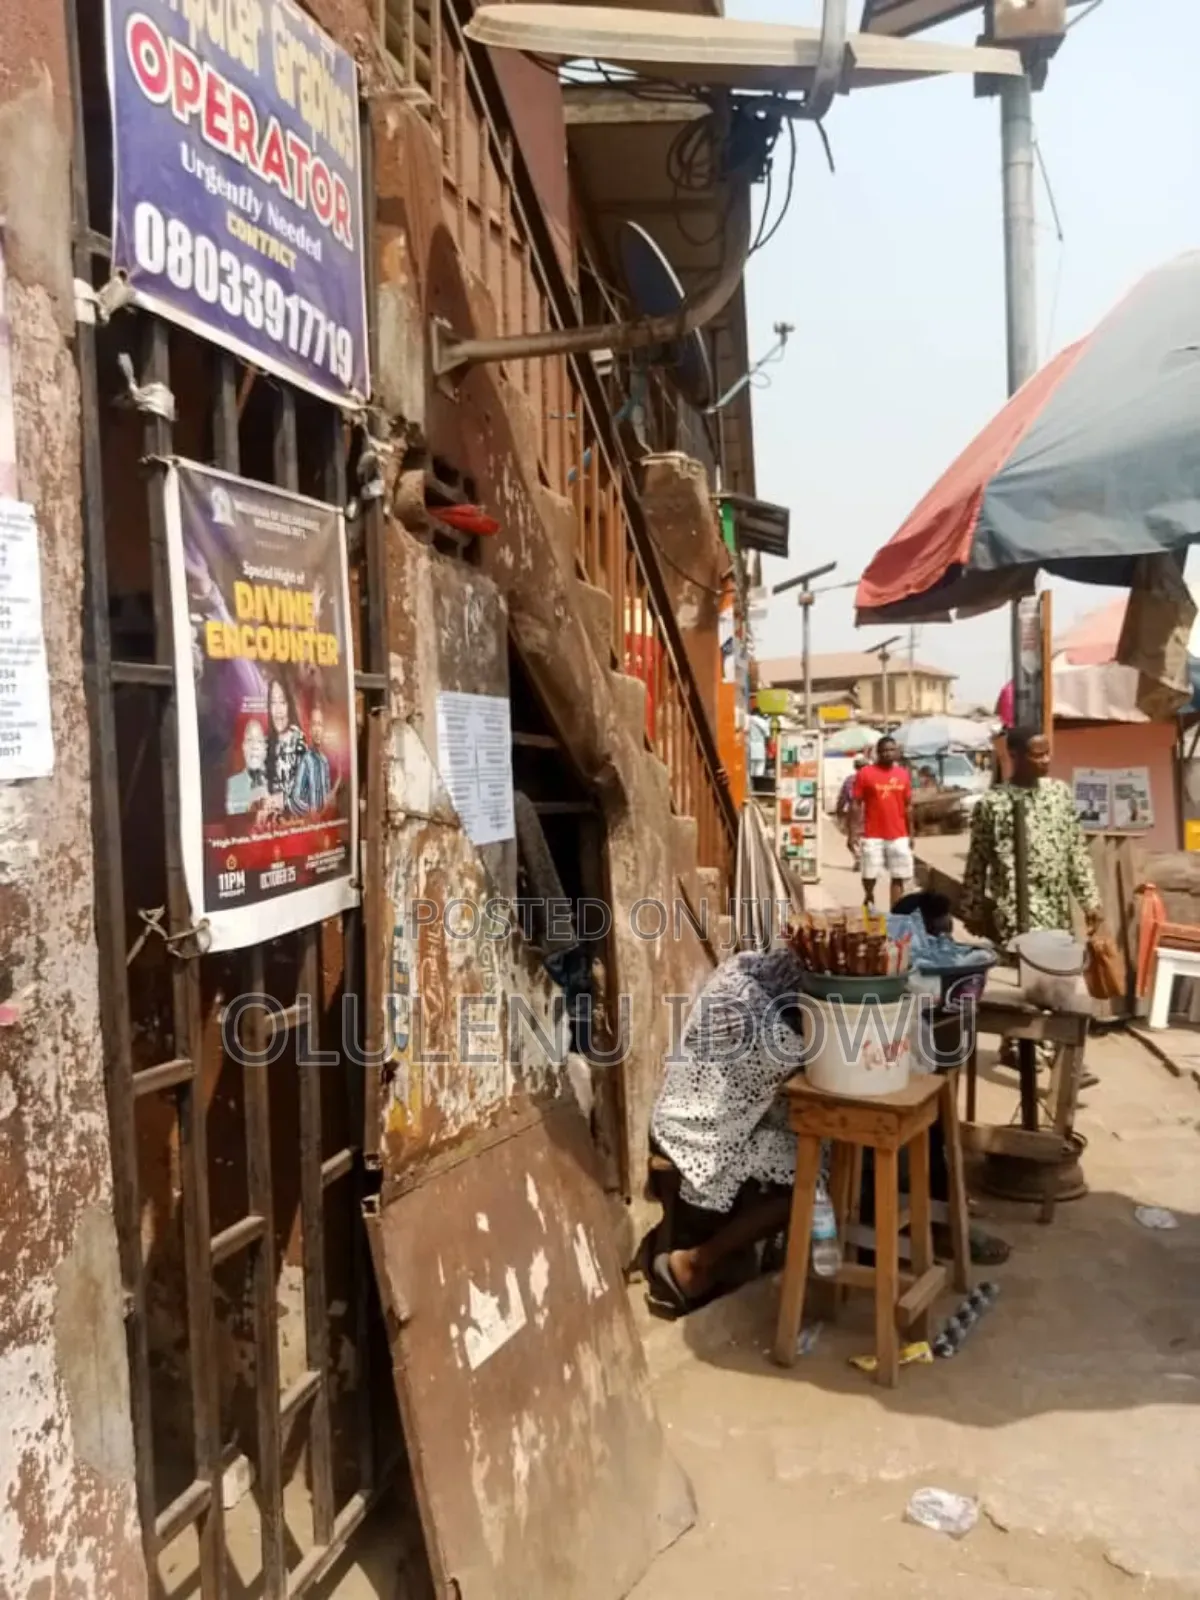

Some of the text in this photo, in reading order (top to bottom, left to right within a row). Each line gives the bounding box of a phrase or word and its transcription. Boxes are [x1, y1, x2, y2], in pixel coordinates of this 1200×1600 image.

[125, 12, 353, 251] OPERATOR
[180, 140, 322, 262] Urgently Needed
[226, 210, 297, 272] CONTACT
[133, 202, 354, 390] 08033917719
[233, 580, 315, 627] DIVINE
[205, 620, 338, 666] ENCOUNTER
[218, 868, 246, 892] 11PM
[259, 868, 287, 890] OCTOBER
